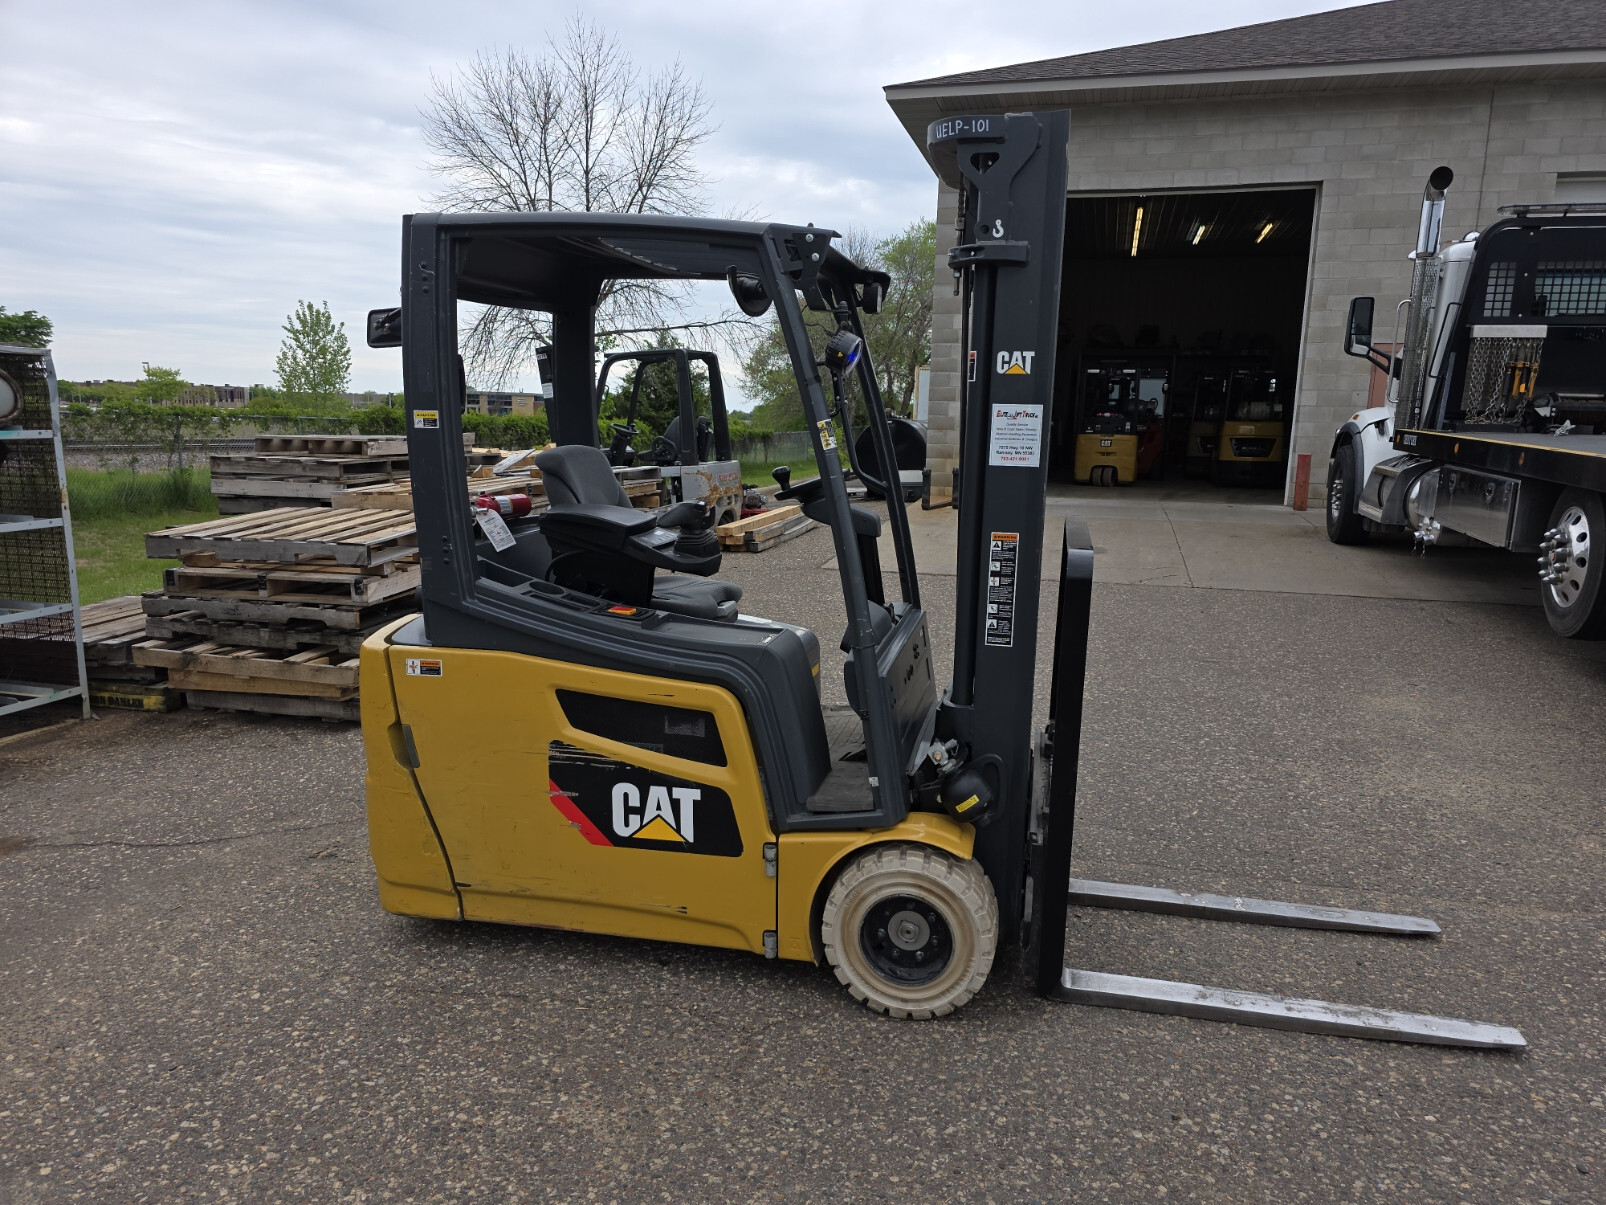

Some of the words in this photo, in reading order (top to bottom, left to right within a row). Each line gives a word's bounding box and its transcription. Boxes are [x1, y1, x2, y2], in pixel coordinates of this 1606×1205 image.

[936, 120, 989, 138] UELP-101
[996, 351, 1035, 374] CAT
[612, 782, 701, 843] CAT
